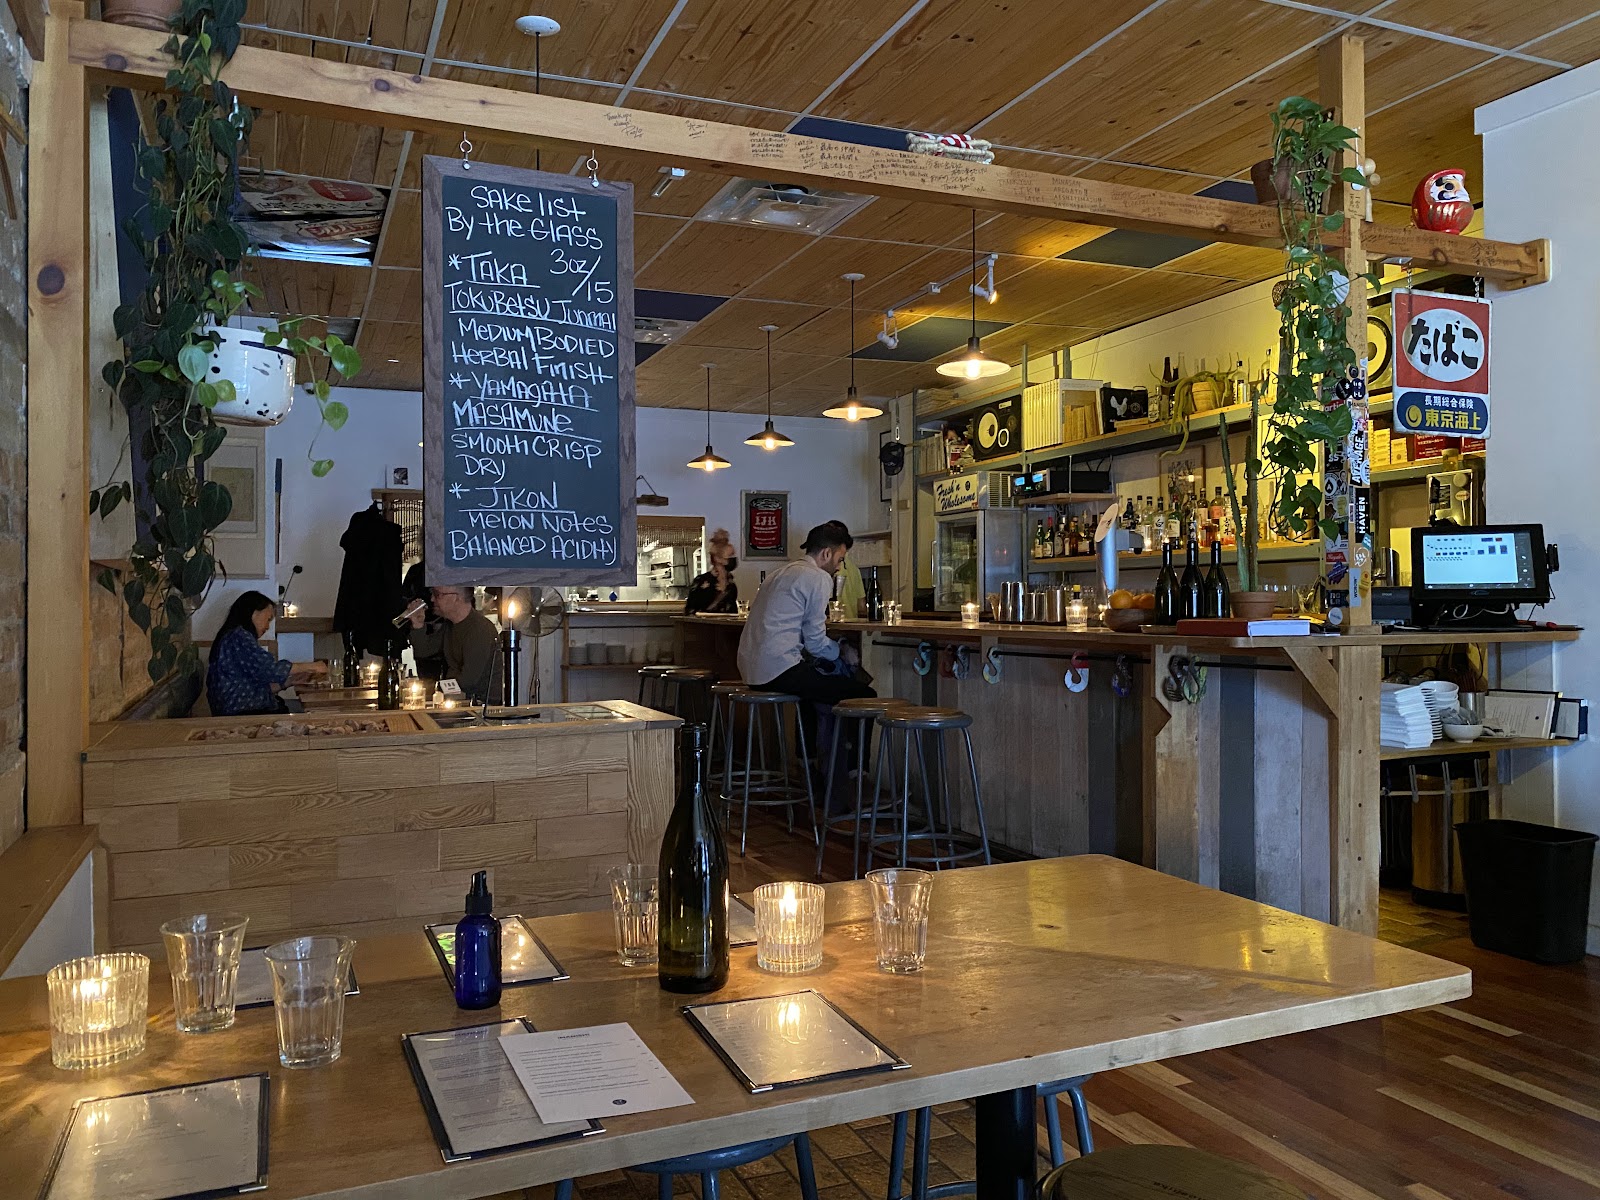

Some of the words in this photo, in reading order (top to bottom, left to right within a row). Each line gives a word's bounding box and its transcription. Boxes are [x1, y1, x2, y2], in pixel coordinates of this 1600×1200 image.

[445, 206, 474, 240] By
[478, 212, 526, 238] the
[460, 251, 528, 285] TAKA
[1407, 317, 1479, 370] たばこ
[1424, 407, 1482, 431] 東京海上
[941, 491, 976, 512] Wholesome
[1358, 496, 1366, 534] HAVEN
